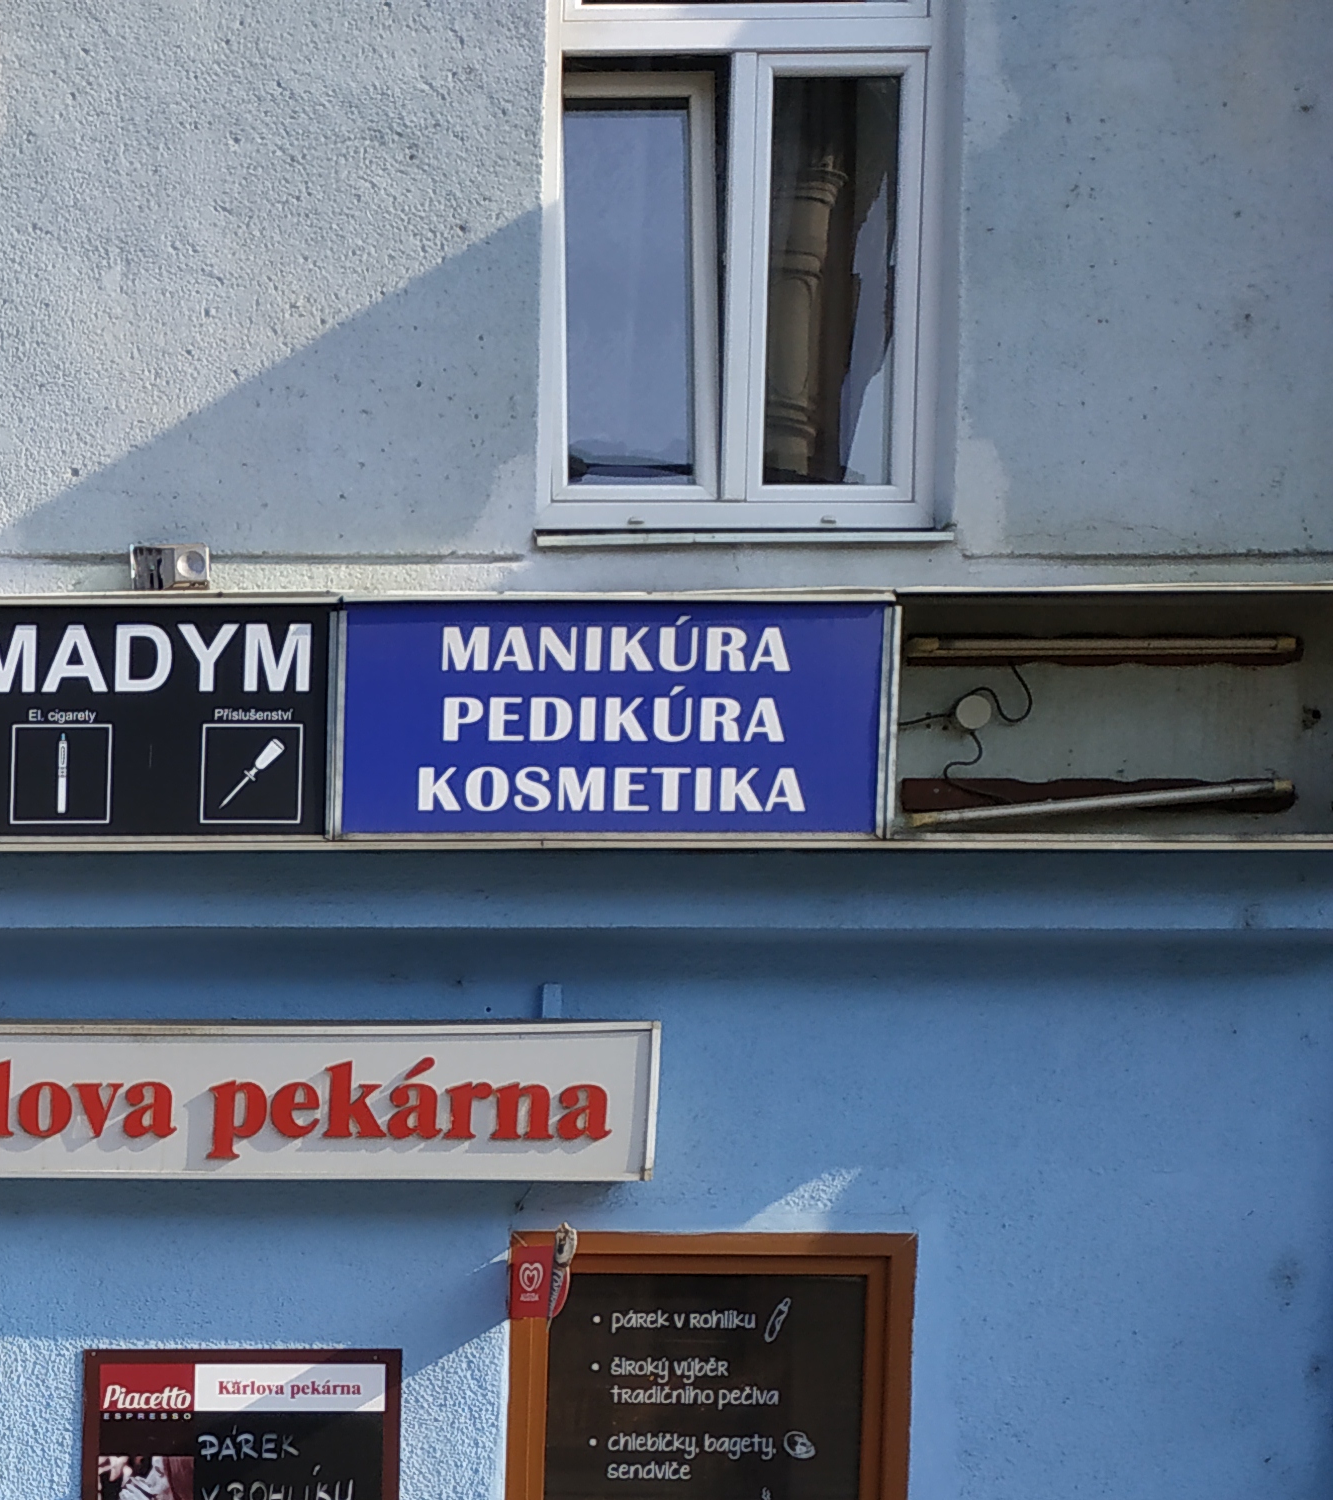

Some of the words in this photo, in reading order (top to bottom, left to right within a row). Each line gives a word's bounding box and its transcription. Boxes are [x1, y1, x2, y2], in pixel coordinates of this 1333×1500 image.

[441, 616, 791, 672] MANIKÚRA
[28, 709, 46, 722] El.
[48, 709, 97, 725] cigarety
[214, 708, 294, 723] Příslušenství
[442, 686, 785, 742] PEDIKÚRA
[417, 766, 806, 813] KOSMETIKA
[206, 1057, 612, 1161] pekárna
[102, 1384, 191, 1410] Piacetto
[218, 1380, 284, 1396] Karlova
[290, 1380, 362, 1399] pekárna
[718, 1385, 779, 1409] pečiva
[103, 1412, 192, 1420] ESPRESSO
[606, 1461, 691, 1480] sendviče
